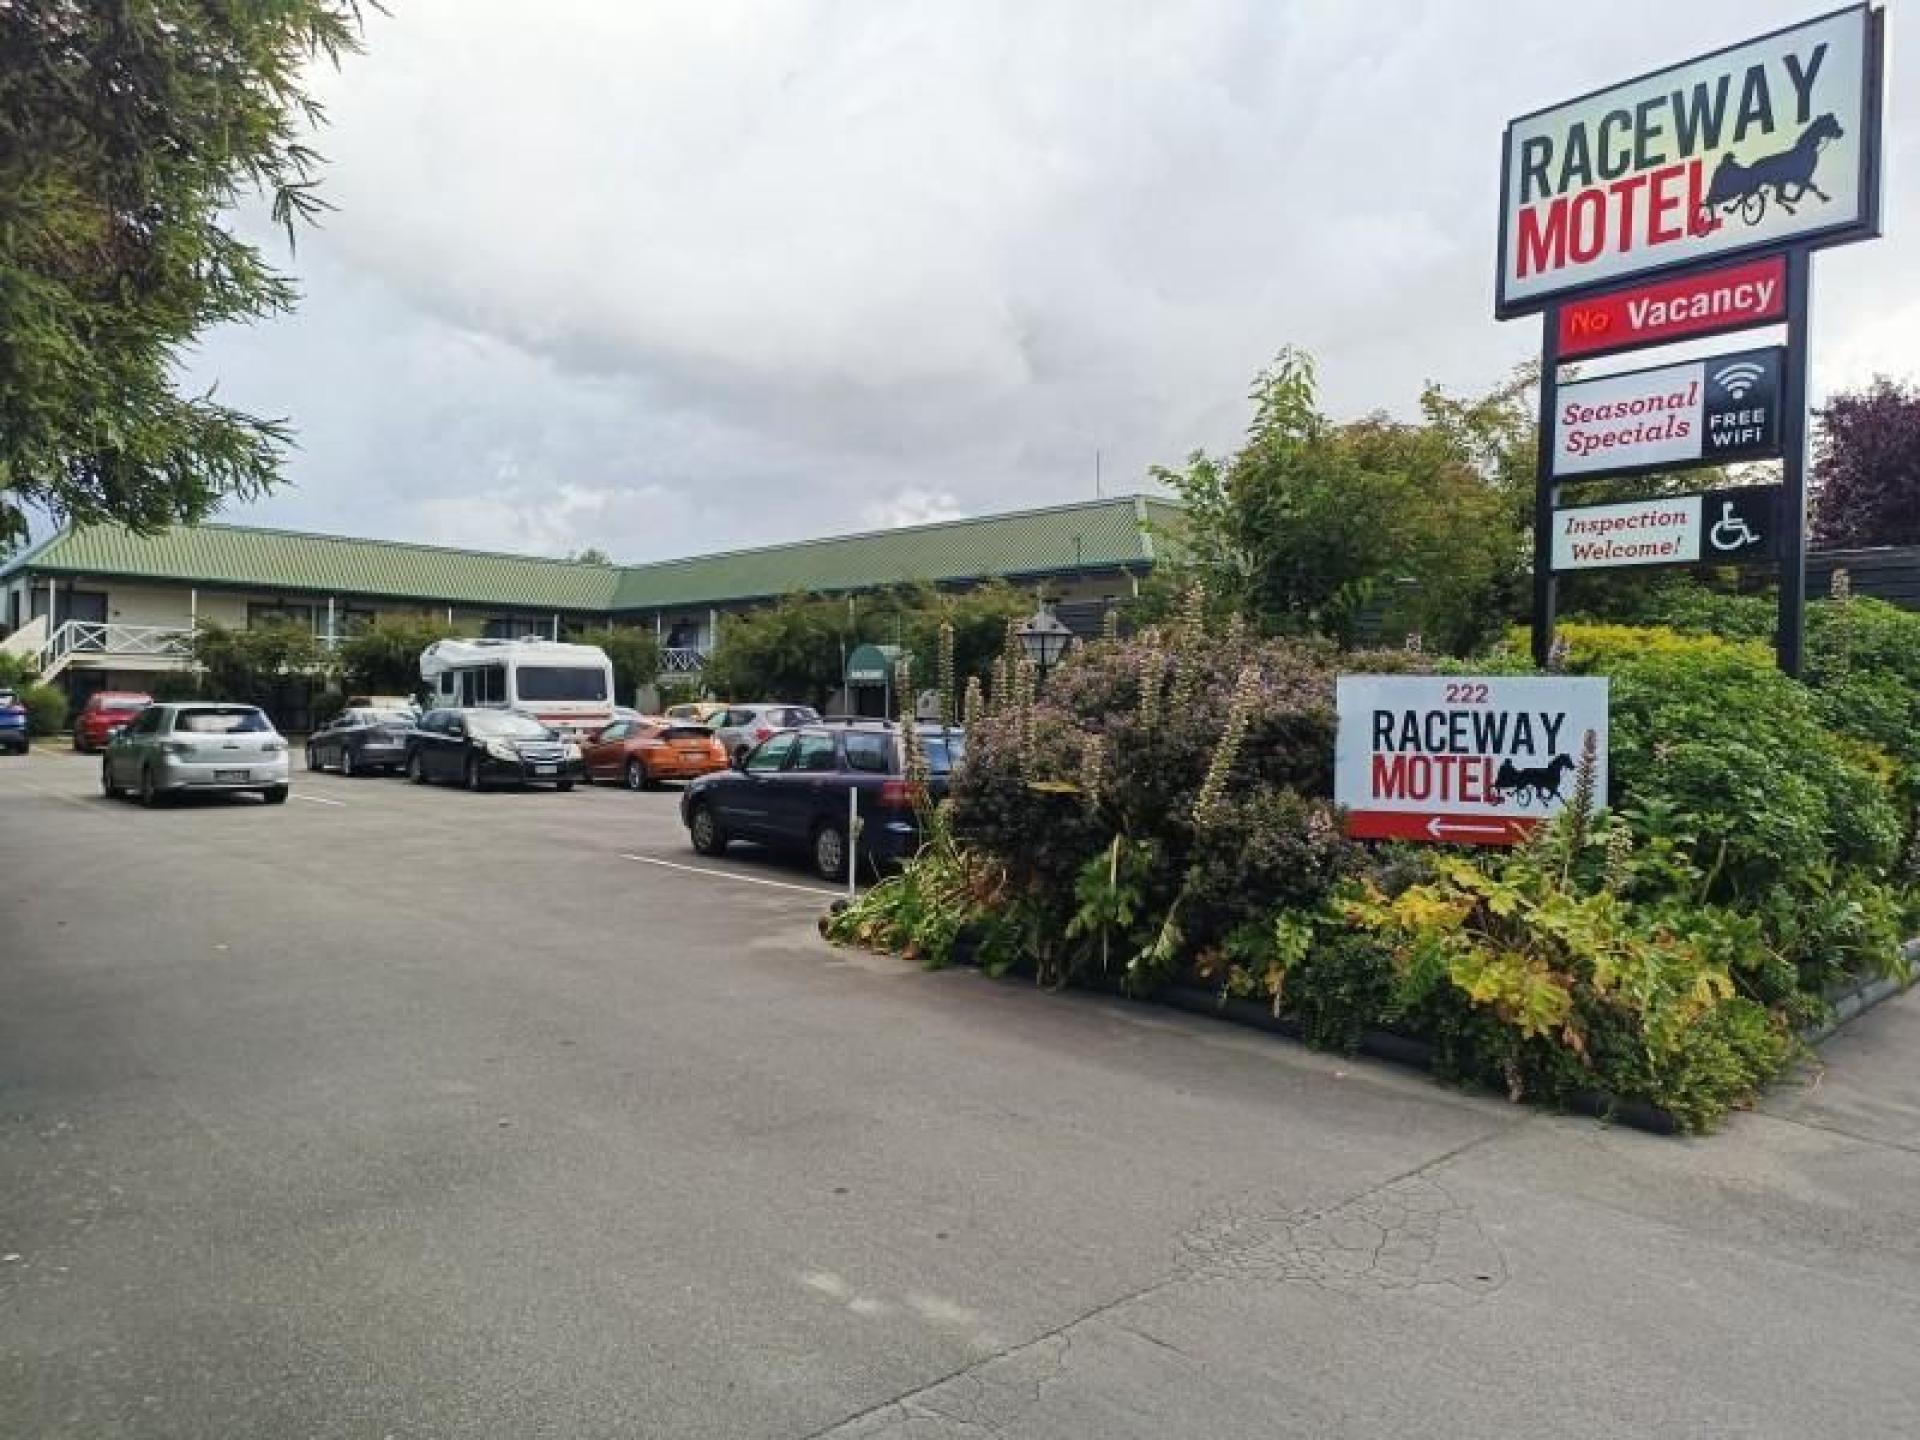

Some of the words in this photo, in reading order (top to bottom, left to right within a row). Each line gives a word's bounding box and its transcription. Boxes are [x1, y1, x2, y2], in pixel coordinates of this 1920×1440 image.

[1519, 42, 1828, 203] RACEWAY
[1516, 159, 1721, 277] MOTEL
[1570, 311, 1610, 336] No
[1627, 279, 1776, 330] Vacancy
[1562, 381, 1698, 426] Seasonal
[1710, 408, 1765, 428] FREE
[1566, 415, 1691, 456] Specials
[1565, 510, 1688, 536] Inspection
[1572, 536, 1682, 560] Welcome!
[1446, 683, 1488, 703] 222
[1372, 709, 1565, 754] RACEWAY
[1372, 754, 1506, 804] MOTEL
